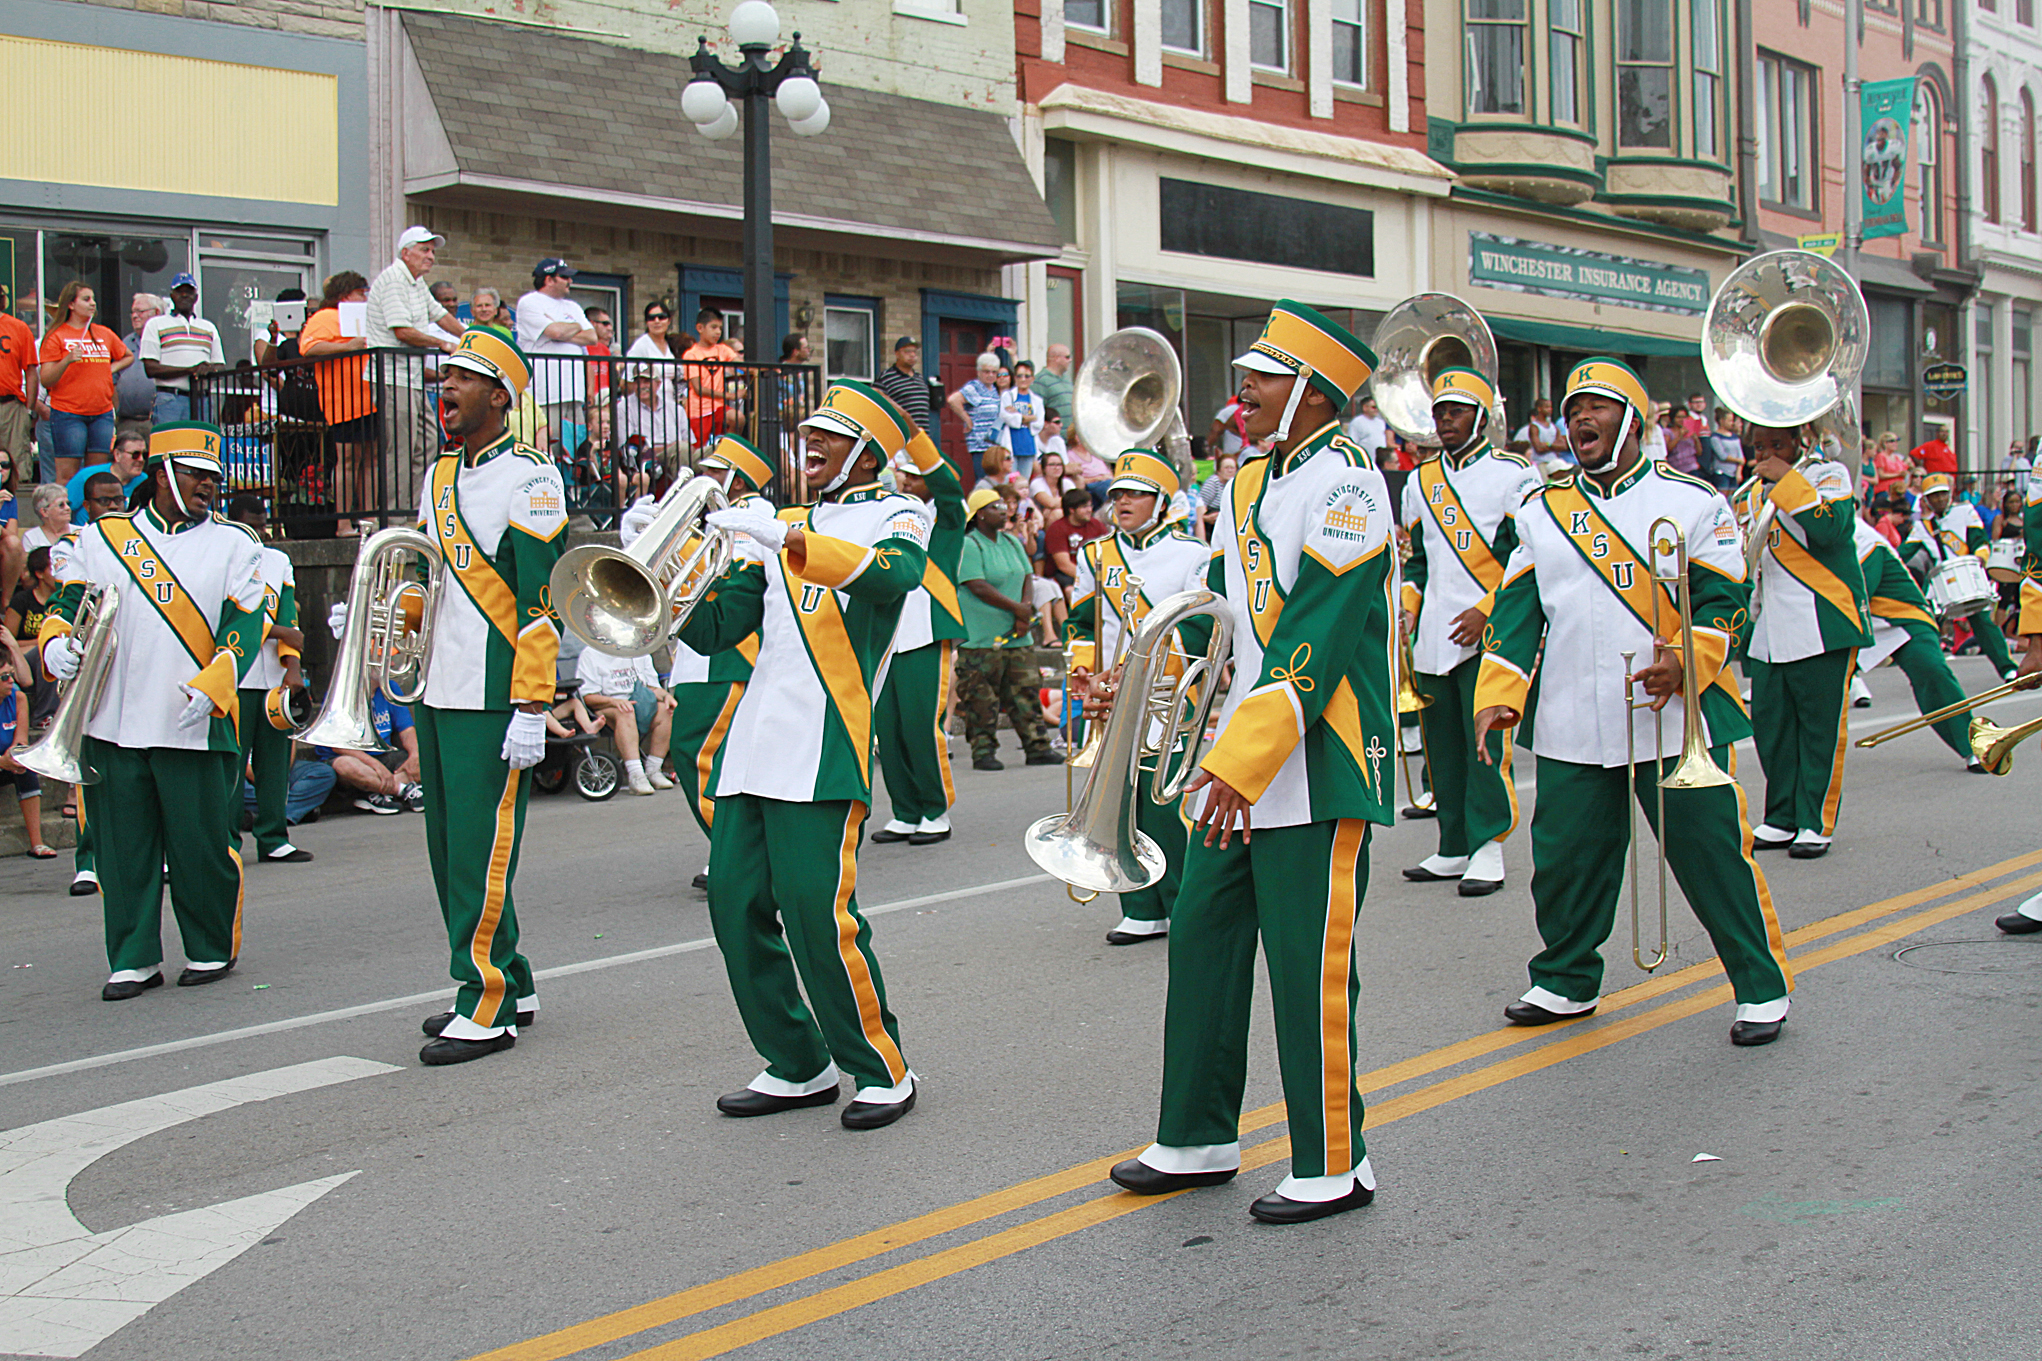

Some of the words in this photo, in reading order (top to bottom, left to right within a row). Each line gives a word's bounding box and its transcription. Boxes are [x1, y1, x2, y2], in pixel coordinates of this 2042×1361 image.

[1481, 251, 1573, 283] WINCHESTER
[1579, 267, 1651, 294] INSURANCE
[1655, 279, 1702, 301] AGENCY
[244, 286, 260, 299] 31
[460, 335, 478, 349] K
[1443, 375, 1455, 388] K
[1577, 367, 1594, 383] K
[822, 390, 841, 407] K
[204, 435, 216, 452] K
[1297, 447, 1312, 463] KSU
[1121, 457, 1136, 471] K
[854, 492, 866, 501] KSU
[1326, 484, 1358, 507] KENTUCKY
[1358, 490, 1376, 514] STATE
[529, 509, 560, 517] UNIVERSITY
[1322, 527, 1366, 543] UNIVERSITY
